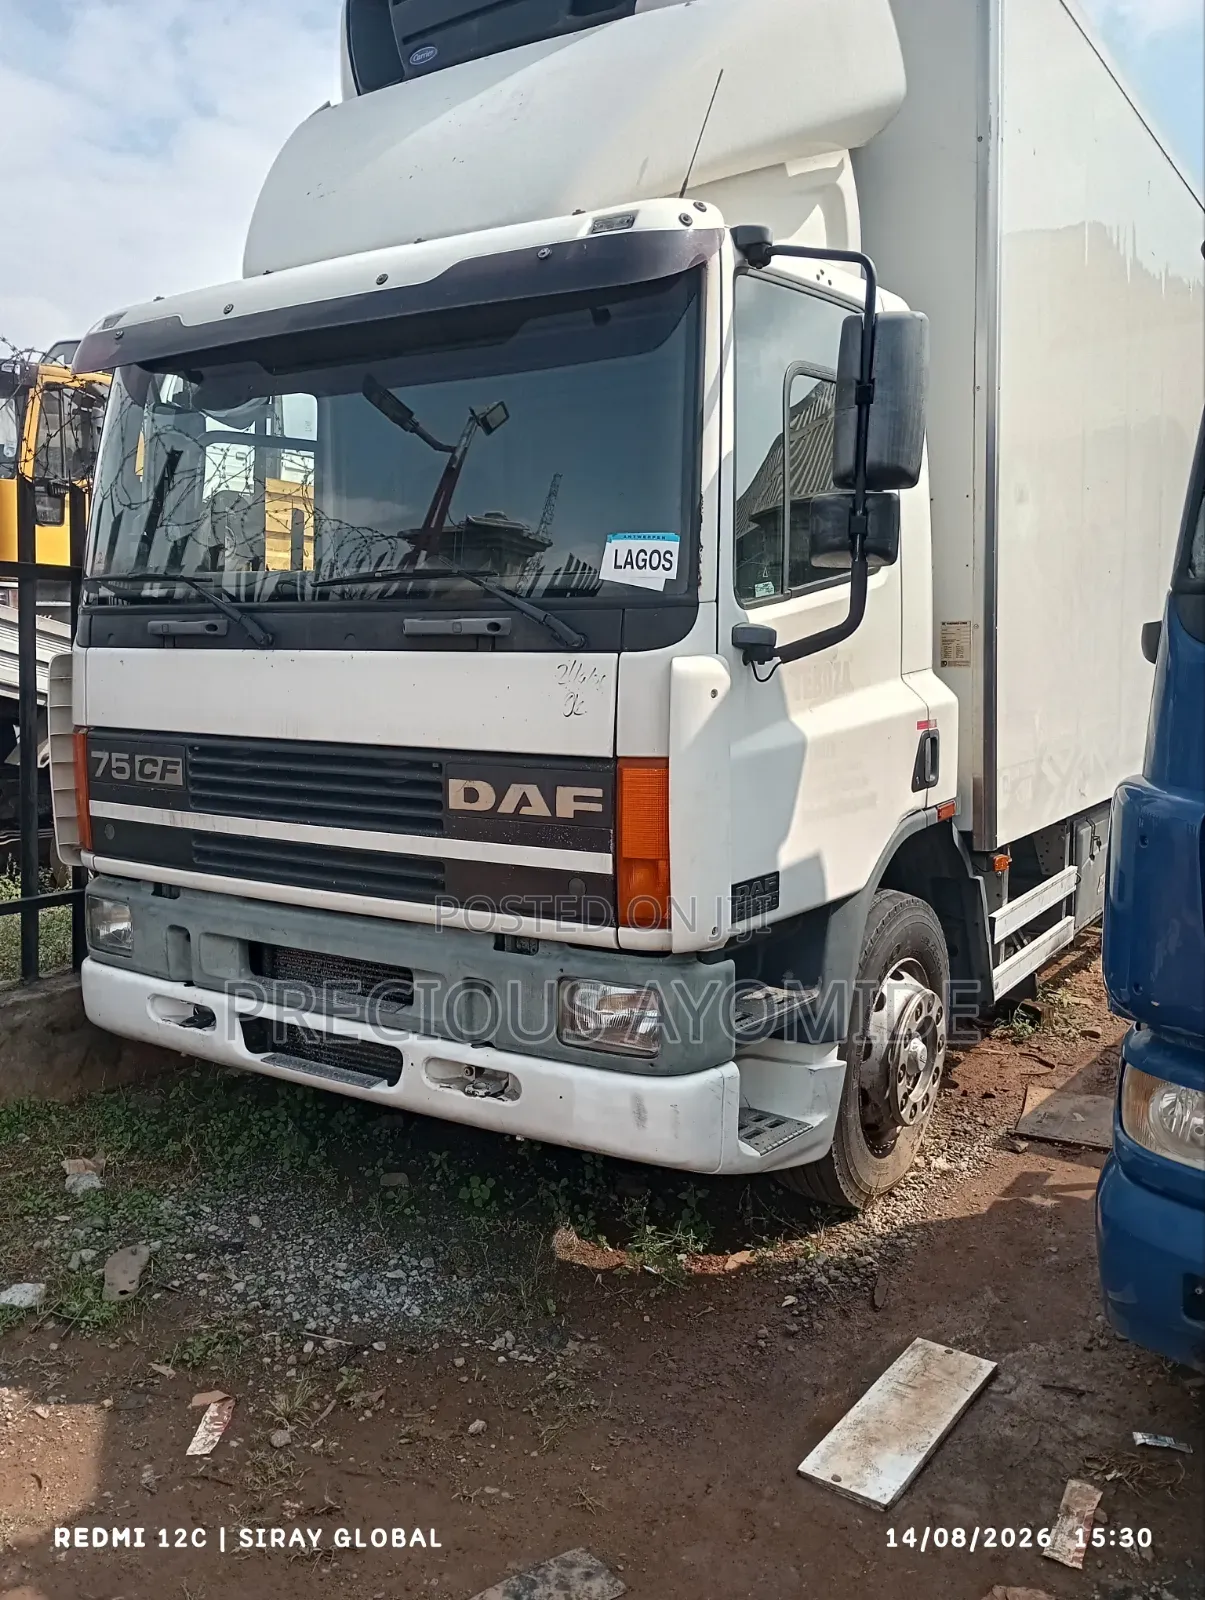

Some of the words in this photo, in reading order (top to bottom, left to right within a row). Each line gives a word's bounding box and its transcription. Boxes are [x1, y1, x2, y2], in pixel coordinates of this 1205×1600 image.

[412, 49, 435, 62] Carrier
[613, 548, 674, 572] LAGOS
[90, 751, 131, 780] 75
[138, 757, 181, 781] CF
[448, 778, 604, 819] DAF
[735, 874, 778, 901] DAF
